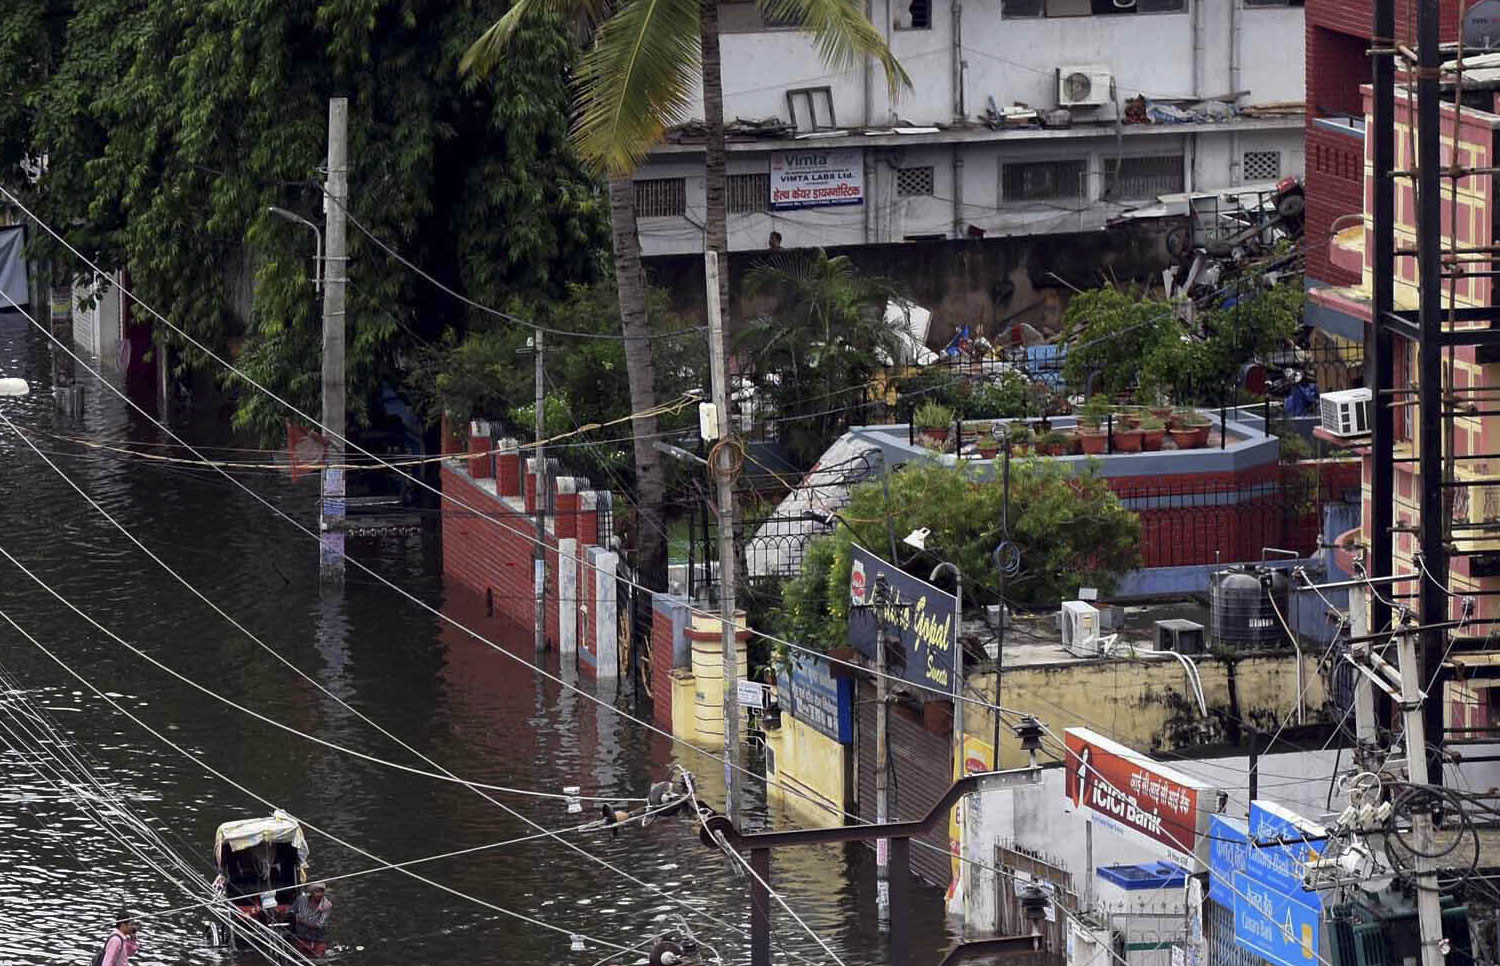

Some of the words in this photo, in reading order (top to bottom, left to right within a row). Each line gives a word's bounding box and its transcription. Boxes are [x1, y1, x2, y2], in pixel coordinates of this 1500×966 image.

[786, 154, 828, 166] Vimta
[780, 174, 809, 182] VIMTA
[812, 173, 835, 181] LABS
[913, 596, 950, 652] Gopal
[1126, 795, 1162, 835] Bank
